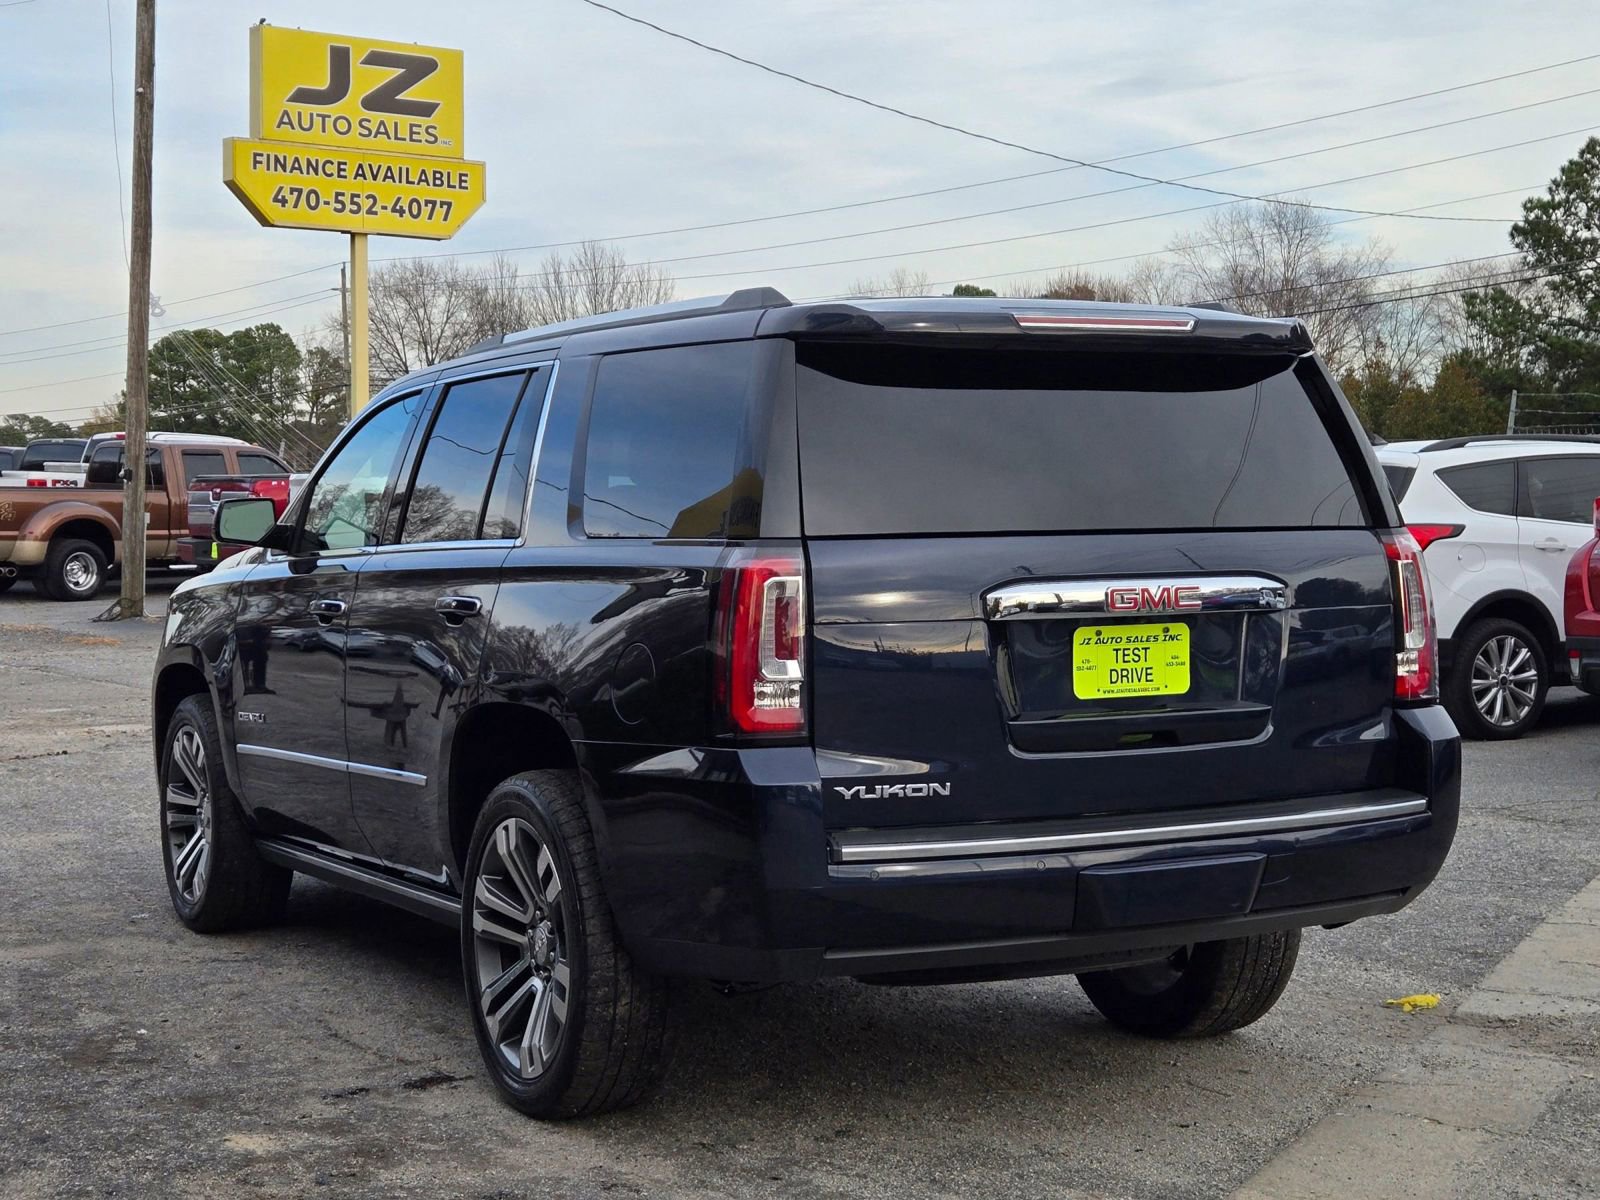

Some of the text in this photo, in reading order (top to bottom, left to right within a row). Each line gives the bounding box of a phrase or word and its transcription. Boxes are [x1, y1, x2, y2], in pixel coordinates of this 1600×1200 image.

[285, 44, 442, 118] JZ
[275, 109, 352, 137] AUTO
[358, 117, 439, 145] SALES
[252, 152, 469, 190] FINANCE AVAILABLE
[271, 185, 453, 222] 470-552-4077
[1106, 585, 1202, 612] GMC
[1079, 637, 1093, 646] JZ
[1094, 636, 1123, 645] AUTO
[1125, 634, 1159, 644] SALES
[1112, 646, 1151, 664] TEST
[1109, 666, 1154, 685] DRIVE
[833, 782, 951, 800] YUKON
